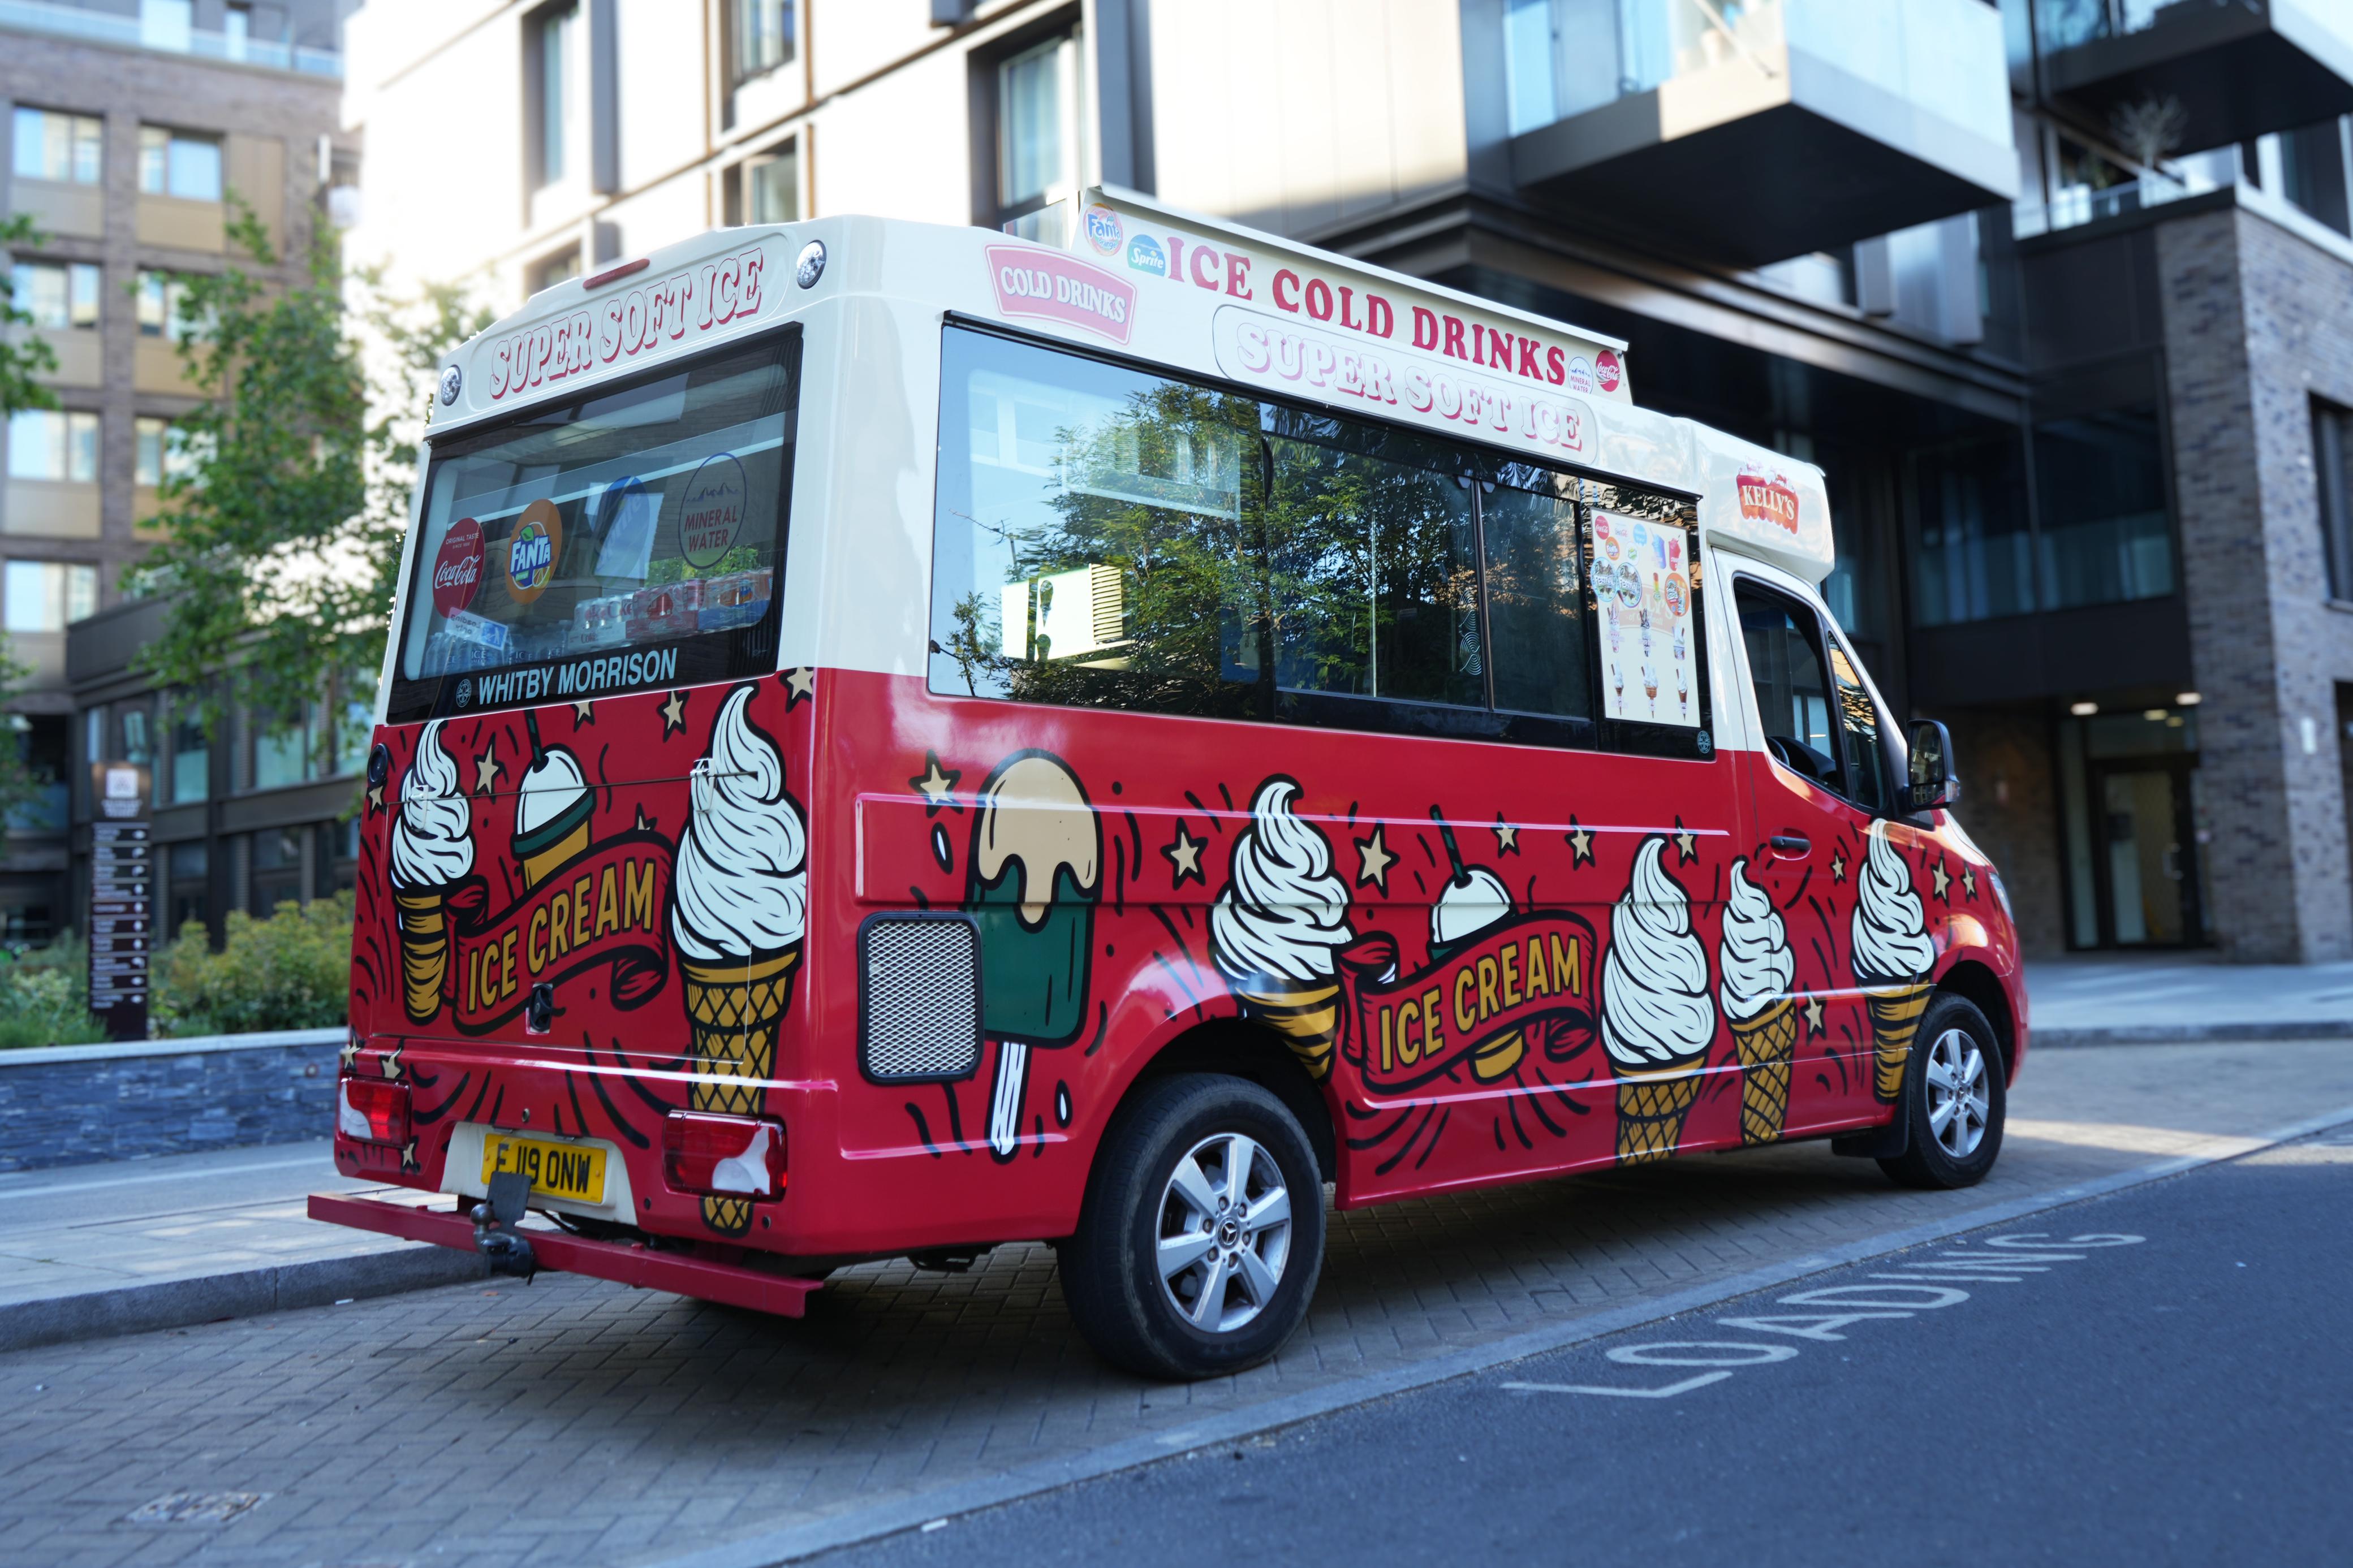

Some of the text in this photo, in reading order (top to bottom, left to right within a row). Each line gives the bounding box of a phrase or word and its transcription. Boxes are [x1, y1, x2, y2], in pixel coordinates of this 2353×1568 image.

[1088, 214, 1121, 240] Fanta
[1131, 248, 1163, 268] Sprite
[1001, 266, 1127, 324] COLD DRINKS
[1167, 237, 1565, 386] ICE COLD DRINKS
[490, 247, 764, 400] SUPER SOFT ICE
[1236, 322, 1582, 452] SUPER SOFT ICE
[1570, 375, 1591, 387] MINERAL
[1573, 385, 1589, 394] WATER
[684, 506, 738, 532] MINERAL
[1742, 485, 1795, 520] KELLY'S
[446, 532, 480, 545] ORIGINAL TASTE
[688, 529, 729, 552] WATER
[434, 555, 481, 589] Coca-Cola
[479, 666, 555, 705] WHITBY
[558, 647, 678, 694] MORRISON
[468, 861, 656, 1013] ICE CREAM
[1380, 934, 1580, 1071] ICE CREAM
[546, 1150, 591, 1194] ONW
[1499, 1233, 2148, 1398] LOADING
